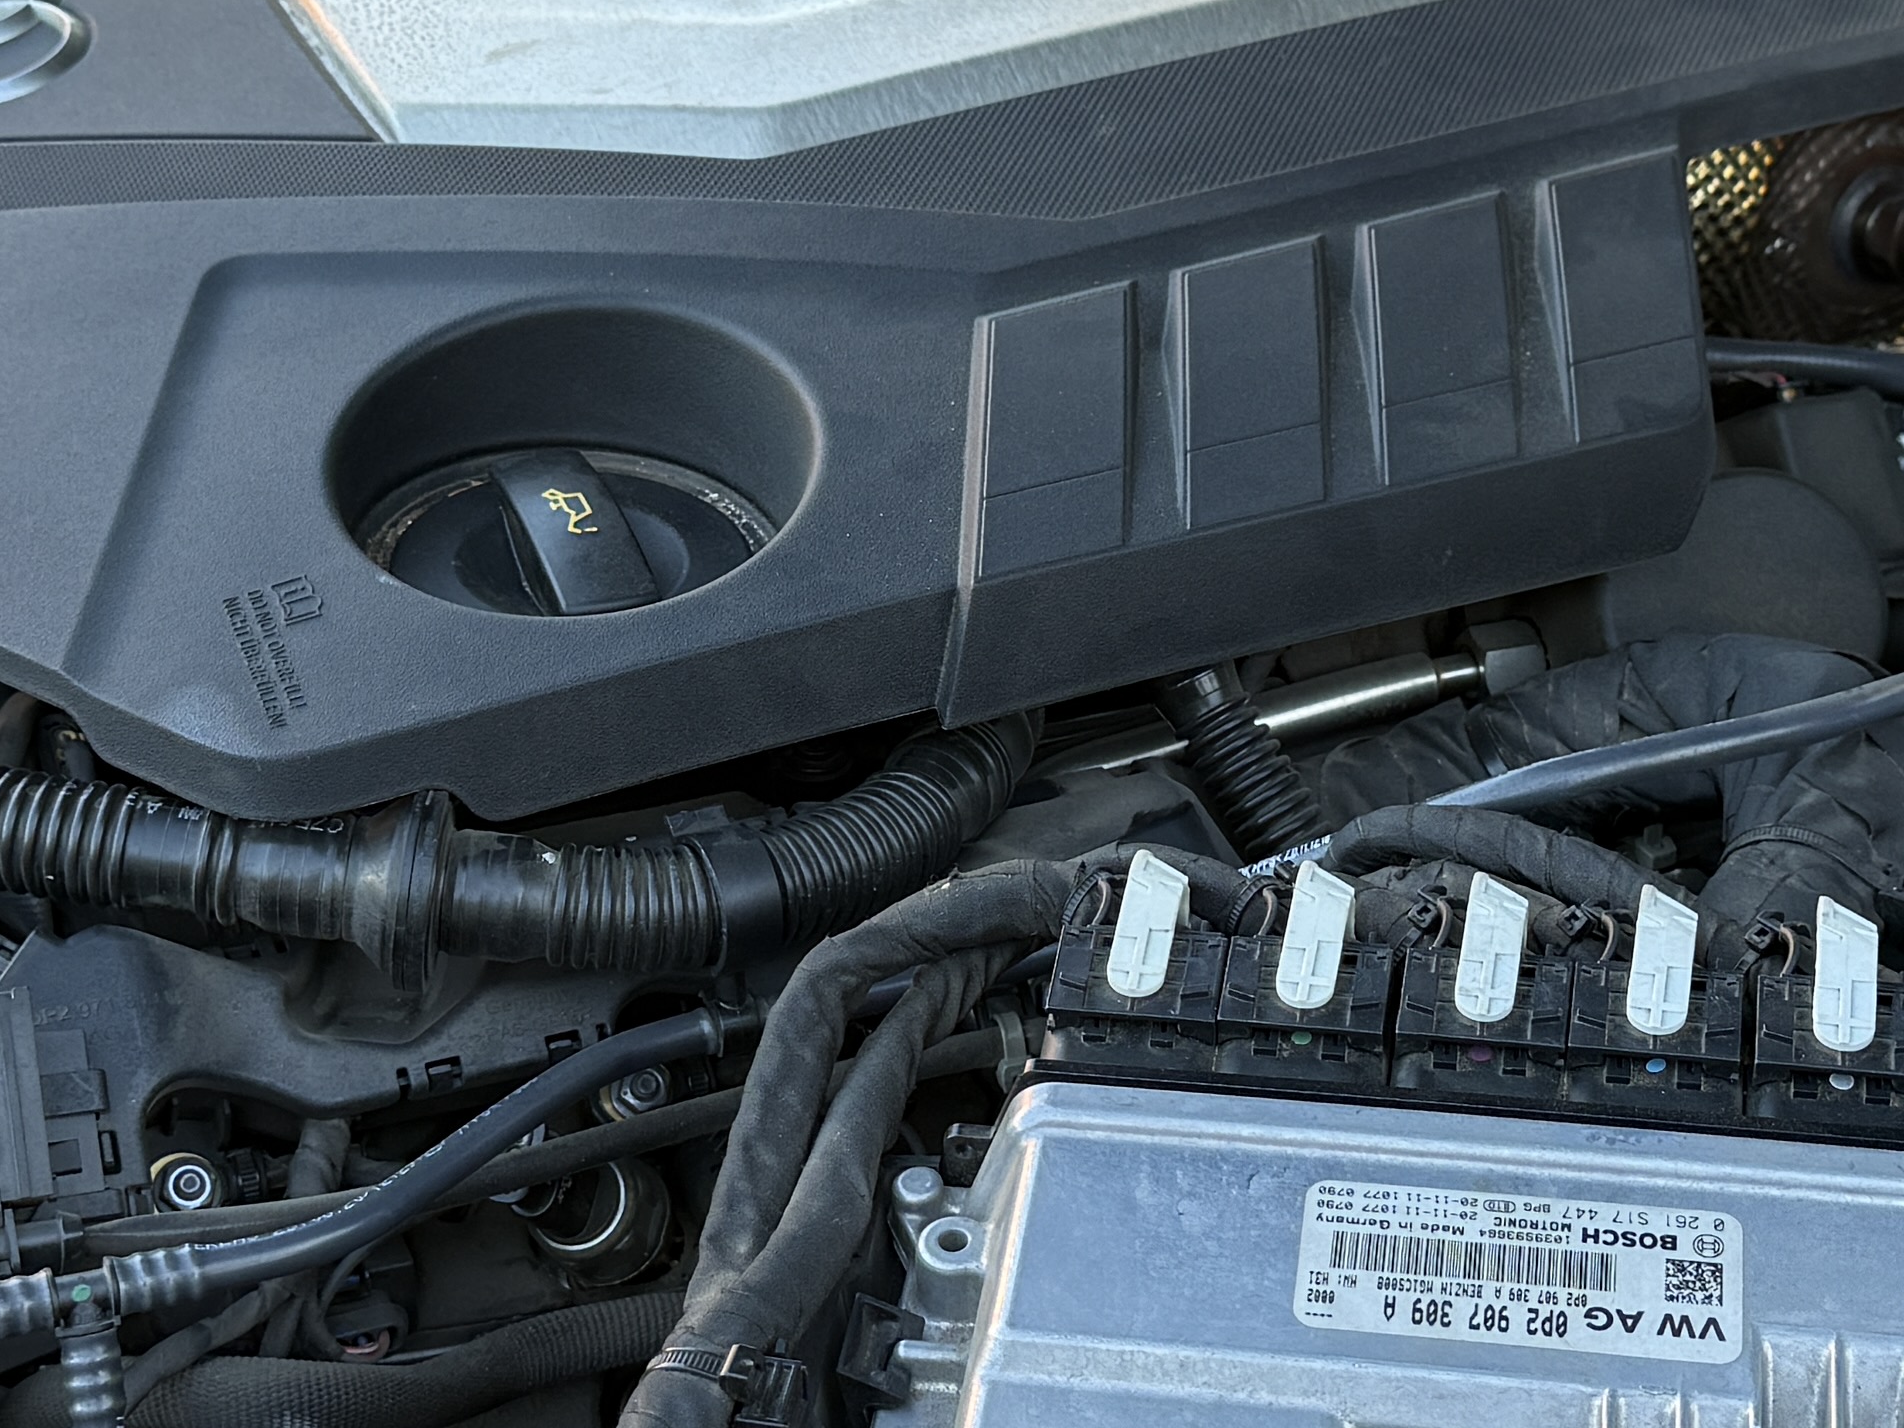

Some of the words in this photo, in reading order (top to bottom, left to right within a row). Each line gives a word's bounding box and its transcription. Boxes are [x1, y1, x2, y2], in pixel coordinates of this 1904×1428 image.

[247, 589, 268, 610] DO
[222, 596, 253, 637] NICHT
[255, 611, 281, 639] NOT
[1362, 1189, 1399, 1201] 1077
[1406, 1192, 1479, 1208] 20-11-11
[1361, 1203, 1397, 1215] 1077
[1405, 1205, 1479, 1221] 20-11-11
[1522, 1201, 1551, 1214] BPG
[1561, 1205, 1599, 1221] 447
[1315, 1212, 1391, 1231] Germany
[1493, 1216, 1572, 1233] MOTRONIC
[1611, 1210, 1649, 1226] S17
[1666, 1213, 1700, 1230] 261
[1398, 1221, 1413, 1233] in
[1420, 1222, 1465, 1237] Made
[1580, 1226, 1678, 1252] BOSCH
[1306, 1287, 1336, 1305] 0002
[1440, 1281, 1484, 1300] BENZIN
[1494, 1285, 1503, 1299] A
[1508, 1287, 1531, 1304] 309
[1537, 1289, 1559, 1306] 907
[1383, 1294, 1397, 1323] A
[1565, 1291, 1588, 1309] 0P2
[1411, 1297, 1454, 1329] 309
[1468, 1302, 1510, 1334] 907
[1582, 1304, 1646, 1334] AG
[1526, 1307, 1569, 1339] 0P2
[1656, 1312, 1727, 1343] VW
